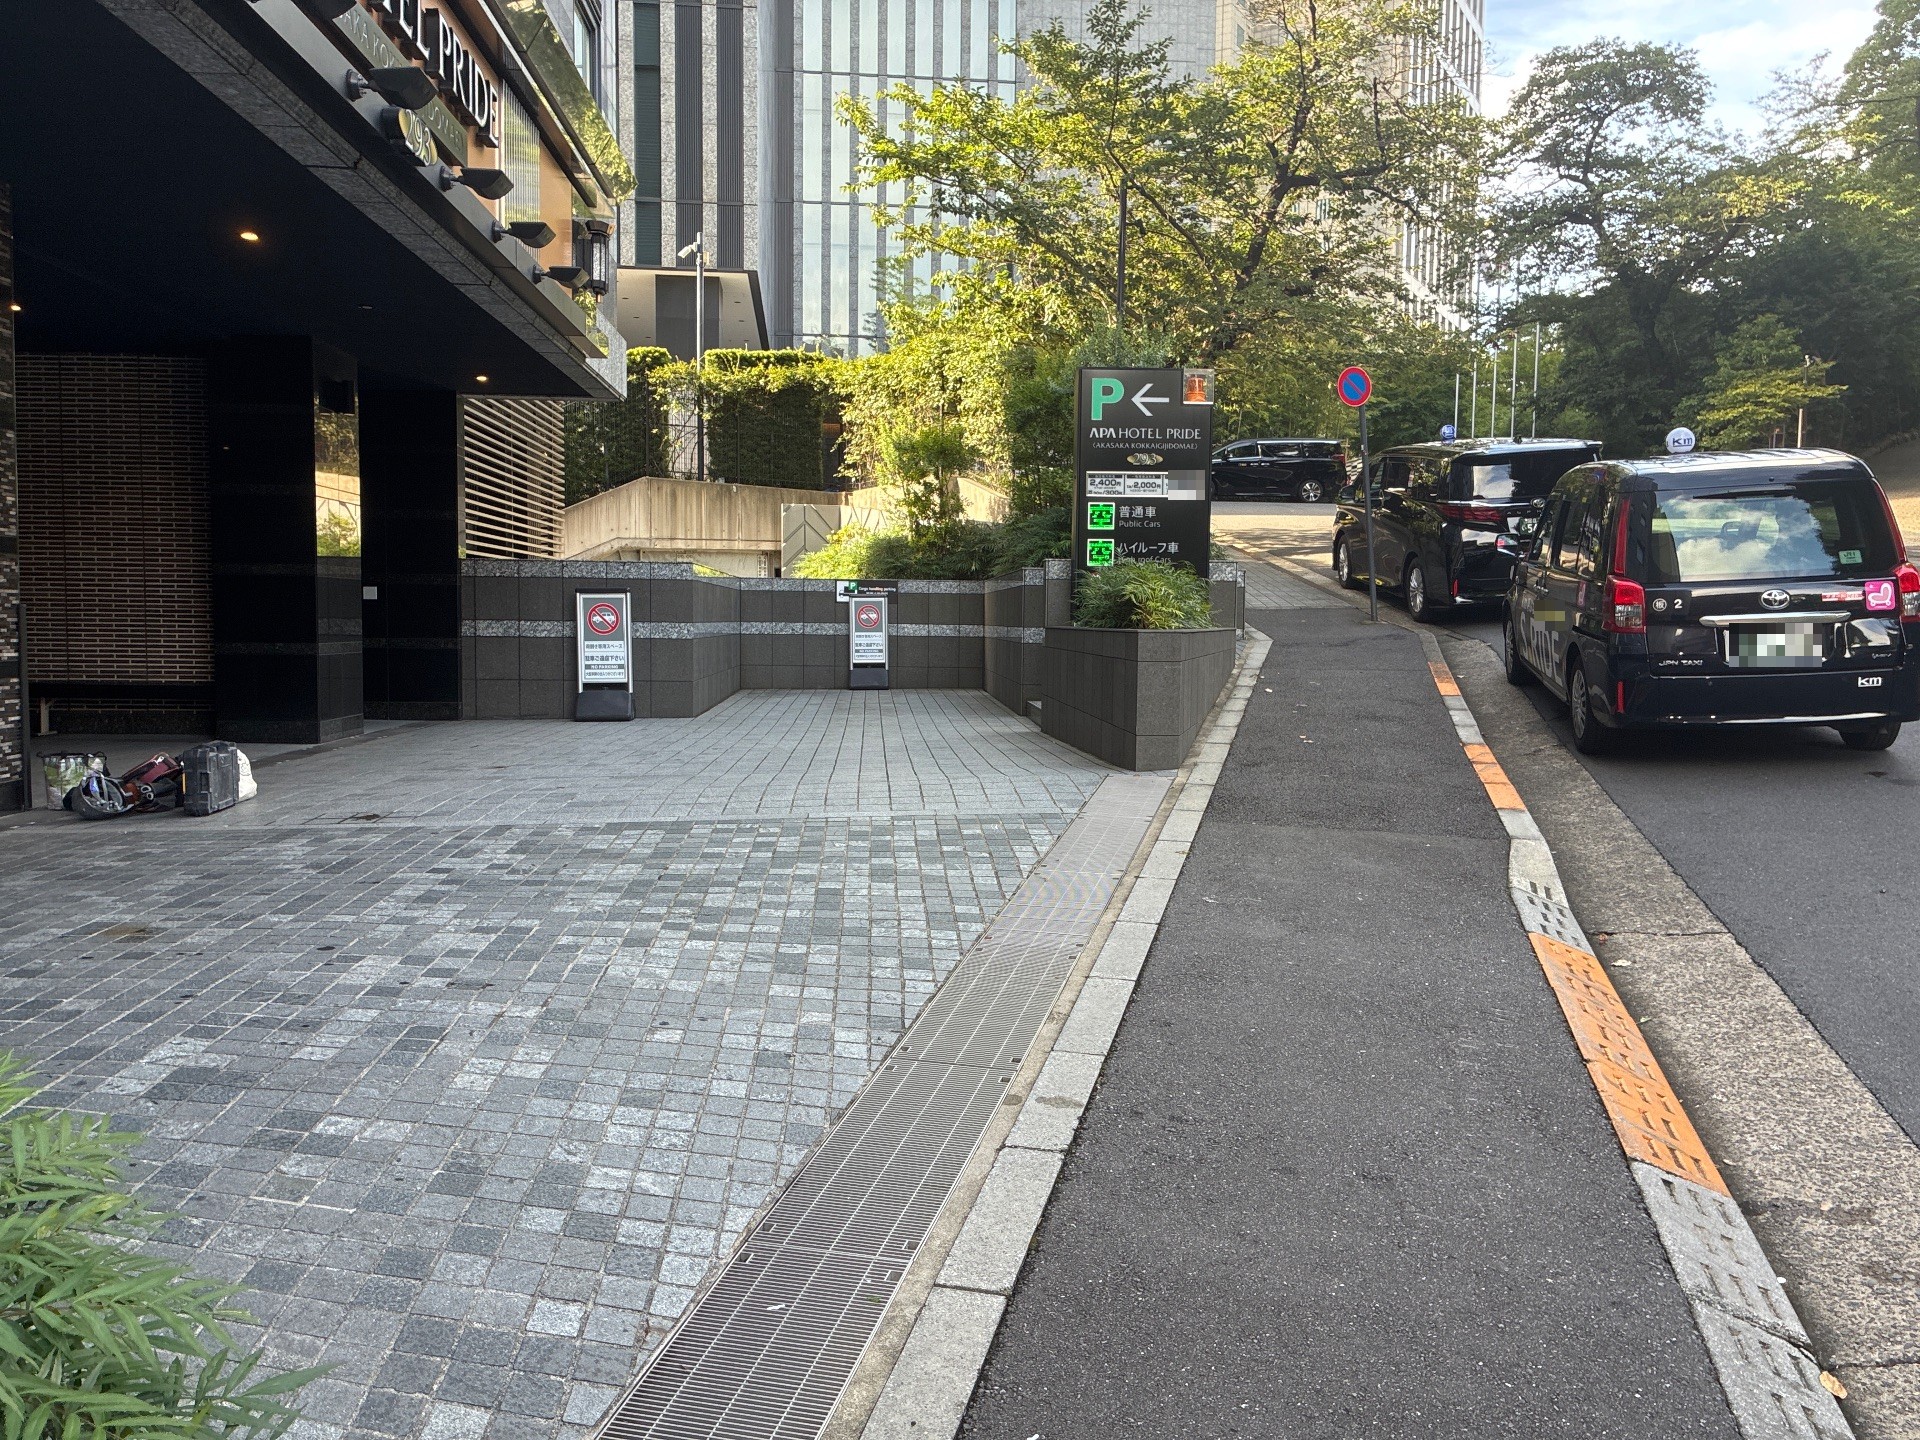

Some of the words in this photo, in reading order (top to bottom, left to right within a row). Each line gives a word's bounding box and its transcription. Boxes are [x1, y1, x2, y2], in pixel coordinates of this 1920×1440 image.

[438, 13, 499, 148] PRIDE
[405, 109, 432, 167] 293
[1090, 377, 1125, 421] P
[1089, 427, 1117, 439] APA
[1118, 427, 1163, 439] HOTEL
[1166, 428, 1202, 440] PRIDE
[1133, 452, 1158, 466] 293
[1118, 505, 1157, 518] 普通車
[1118, 520, 1143, 528] Public
[1143, 520, 1161, 528] Cars
[1118, 541, 1180, 554] ハイルーフ車
[1154, 555, 1172, 563] Cars
[1673, 598, 1683, 609] 2
